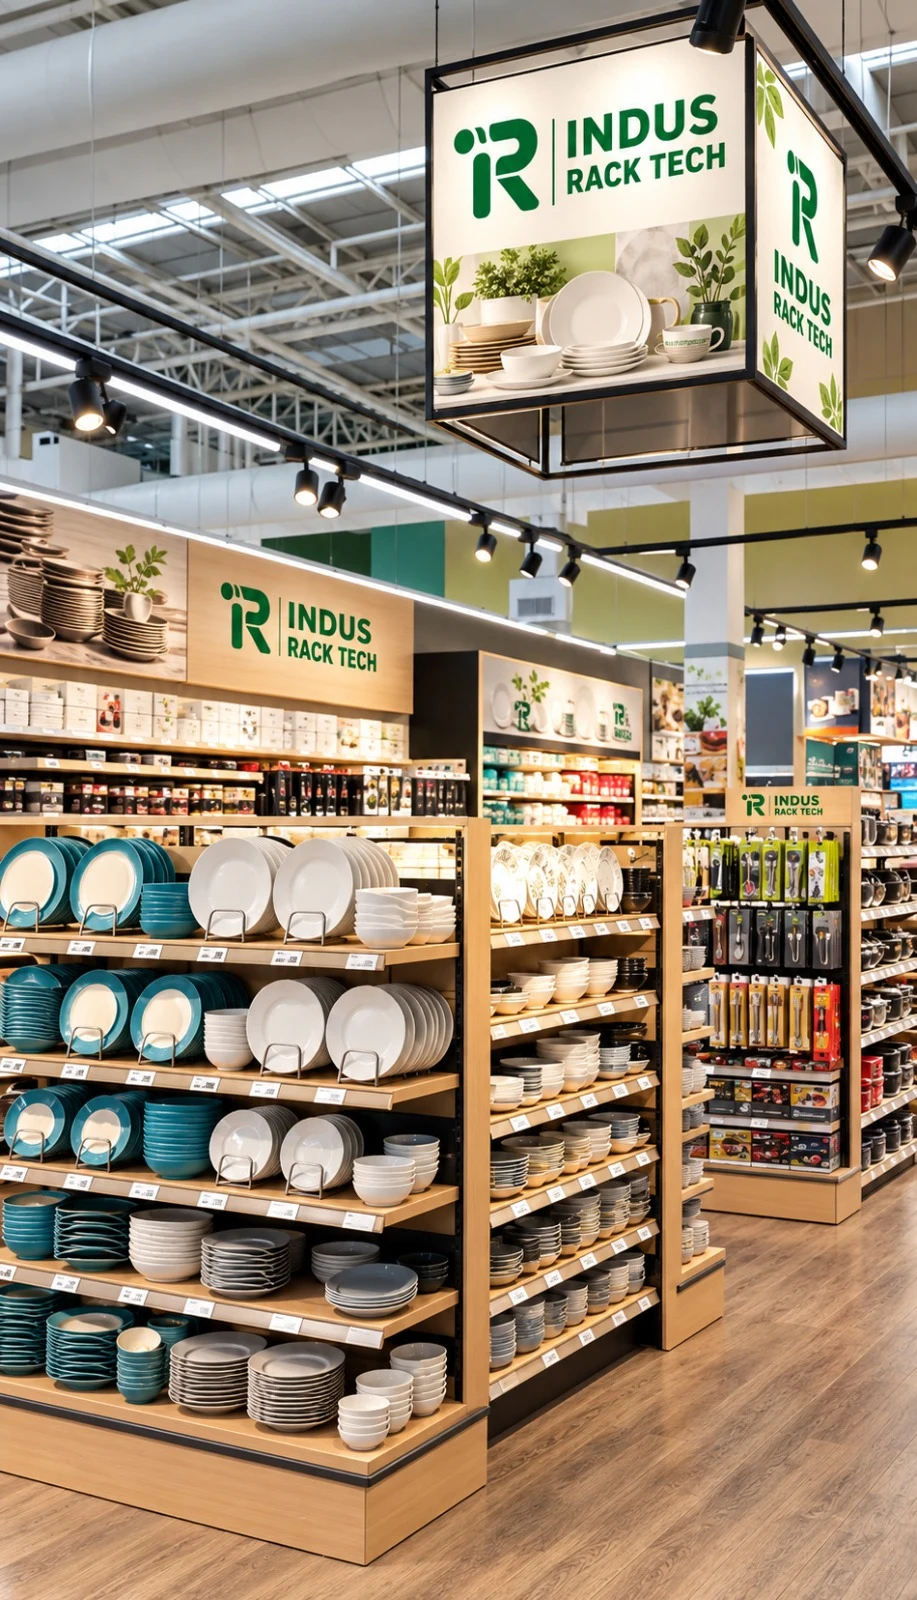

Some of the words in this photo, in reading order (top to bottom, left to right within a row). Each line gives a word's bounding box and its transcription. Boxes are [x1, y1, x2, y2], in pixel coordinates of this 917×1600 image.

[567, 93, 719, 158] INDUS
[567, 157, 641, 195] RACK
[649, 142, 726, 180] TECH
[774, 249, 832, 327] INDUS
[773, 291, 805, 336] RACK
[806, 318, 833, 359] TECH
[288, 601, 372, 645] INDUS
[287, 636, 334, 665] RACK
[338, 646, 377, 672] TECH
[774, 795, 820, 806] INDUS
[774, 808, 798, 816] RACK
[801, 808, 823, 816] TECH
